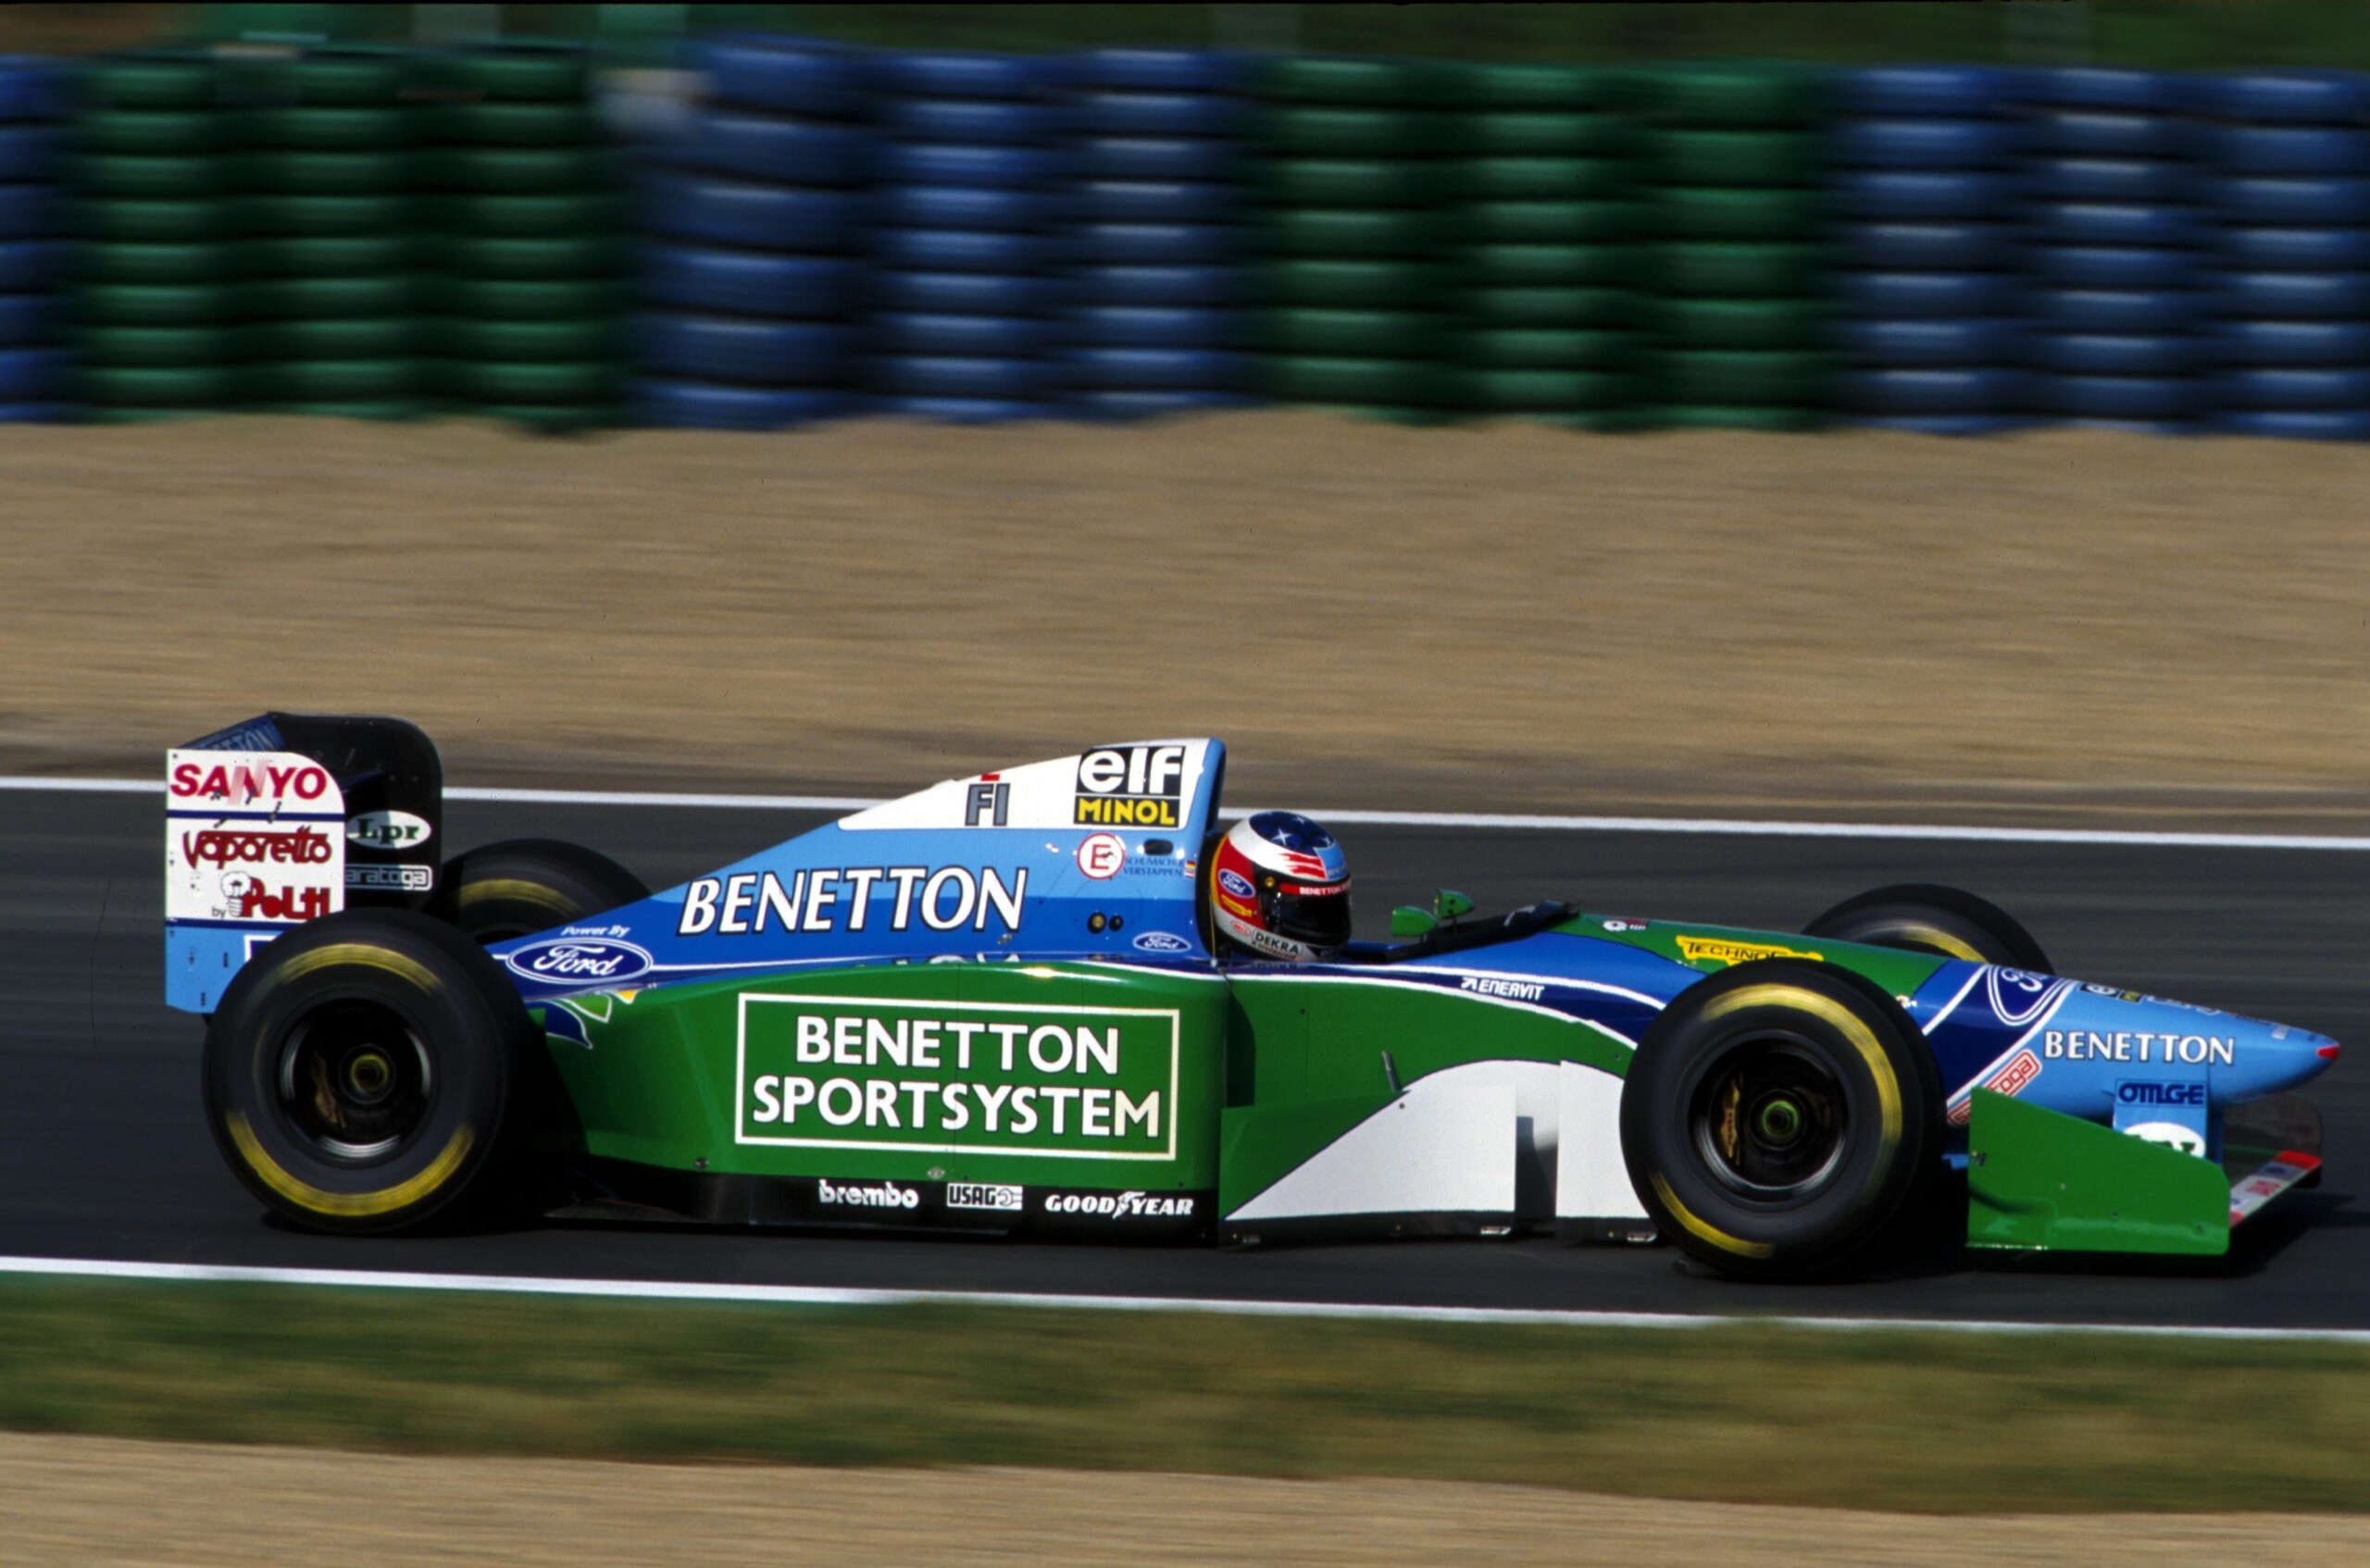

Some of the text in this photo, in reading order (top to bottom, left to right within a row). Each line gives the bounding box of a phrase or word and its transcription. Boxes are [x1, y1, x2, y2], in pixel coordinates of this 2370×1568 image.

[169, 764, 327, 799] SANYO
[1079, 747, 1183, 793] elf
[1078, 799, 1176, 825] MINOL
[182, 825, 331, 869] Vaporetto
[345, 869, 426, 889] aratoga
[1123, 866, 1182, 877] VERSTAPPEN
[211, 906, 227, 919] by
[676, 865, 1029, 935] BENETTON
[1254, 931, 1299, 954] DEKRA
[533, 944, 624, 976] Ford
[1478, 978, 1545, 1002] ENERVIT
[793, 1015, 1120, 1076] BENETTON
[2043, 1029, 2234, 1065] BENETTON
[752, 1075, 1160, 1139] SPORTSYSTEM
[818, 1179, 918, 1209] brembo
[949, 1185, 997, 1207] USAG
[1045, 1191, 1192, 1219] GOODYEAR
